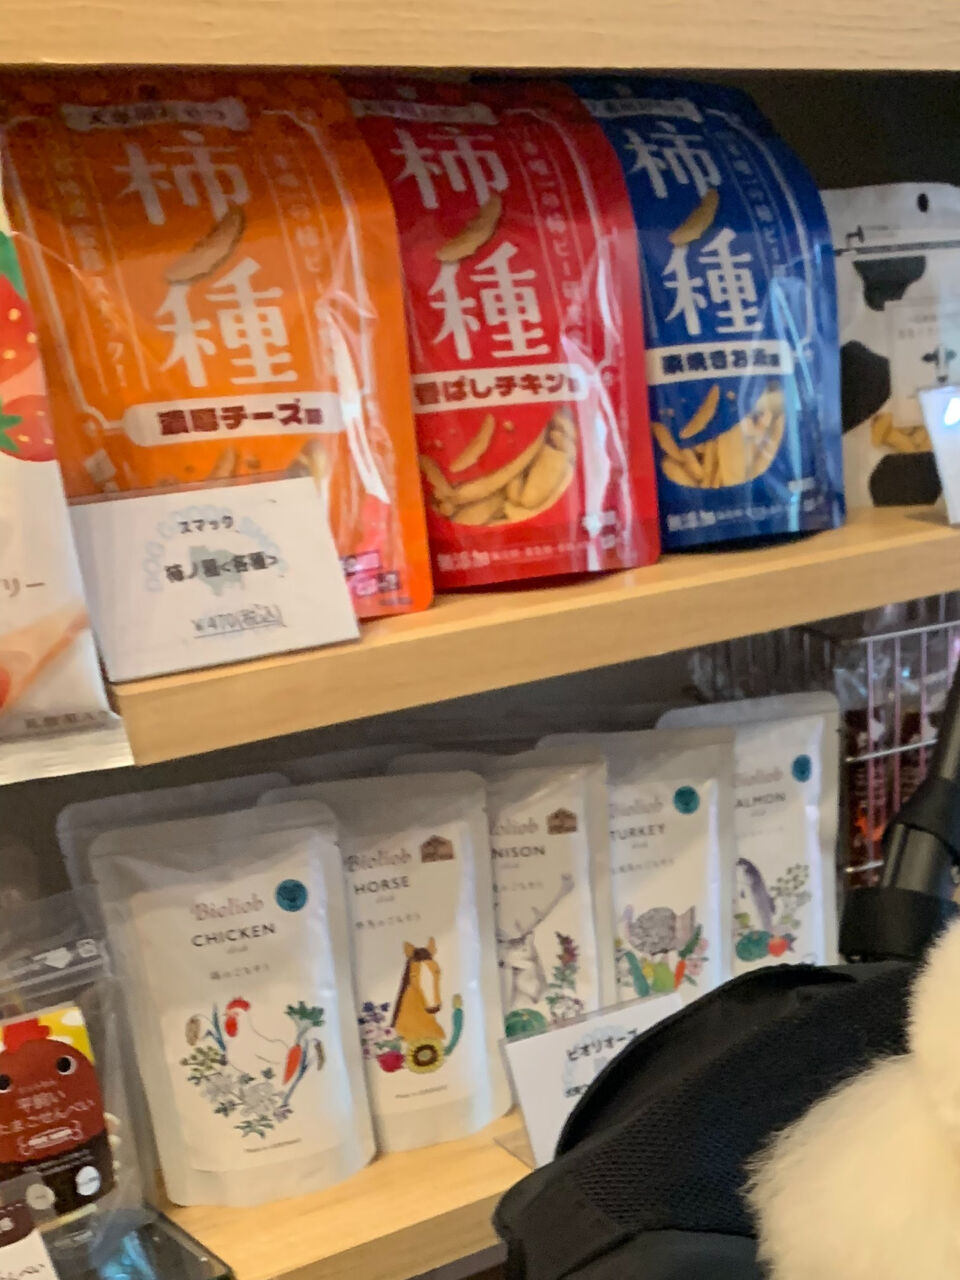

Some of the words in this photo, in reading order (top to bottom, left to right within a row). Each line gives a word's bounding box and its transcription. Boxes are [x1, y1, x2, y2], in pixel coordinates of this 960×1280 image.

[735, 792, 787, 809] ALMON
[491, 845, 546, 859] NISON
[353, 875, 410, 895] HORSE
[191, 922, 276, 947] CHICKEN
